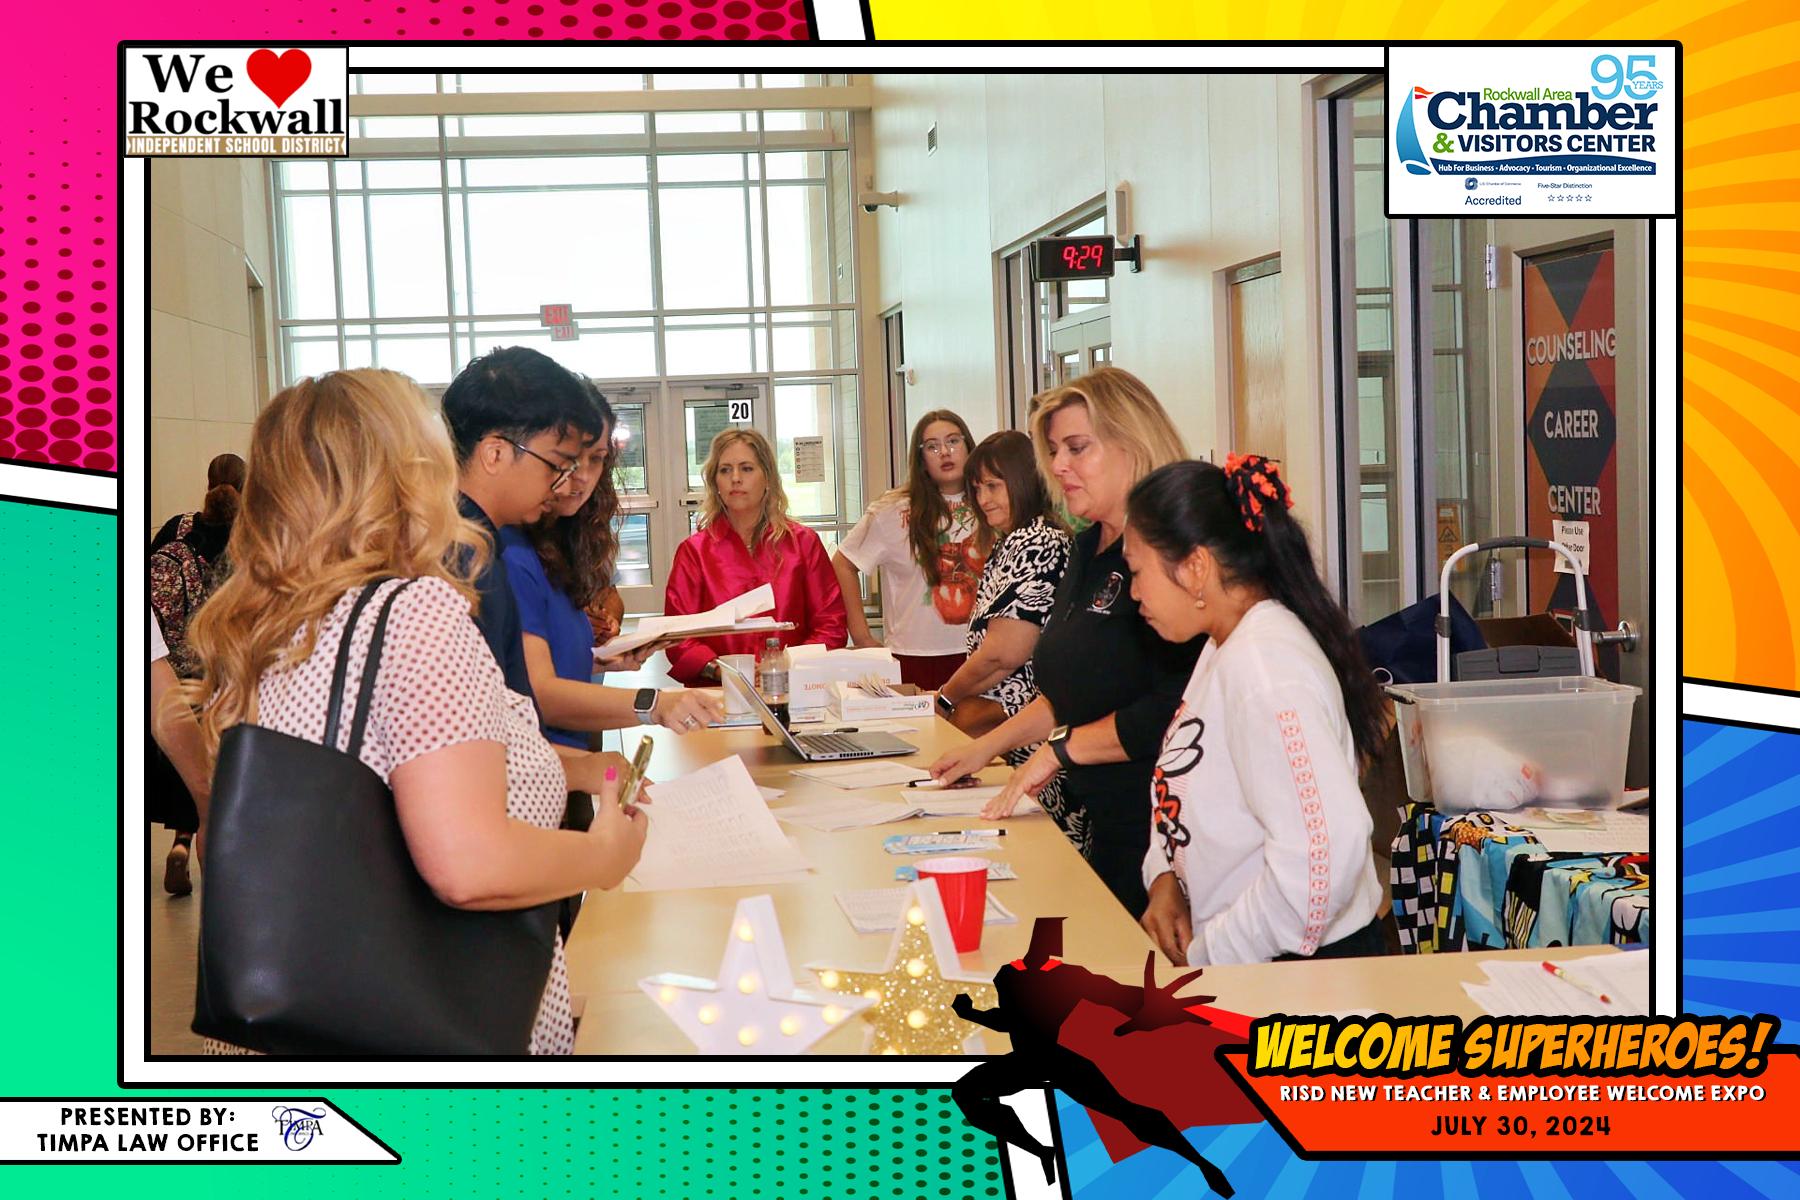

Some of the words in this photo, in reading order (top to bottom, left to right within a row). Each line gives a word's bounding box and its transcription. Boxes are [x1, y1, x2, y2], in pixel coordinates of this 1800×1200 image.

[1062, 244, 1104, 270] 9:29
[1526, 328, 1617, 365] COUNSELING
[731, 402, 749, 420] 20
[1544, 409, 1600, 439] CAREER
[1547, 484, 1602, 515] CENTER
